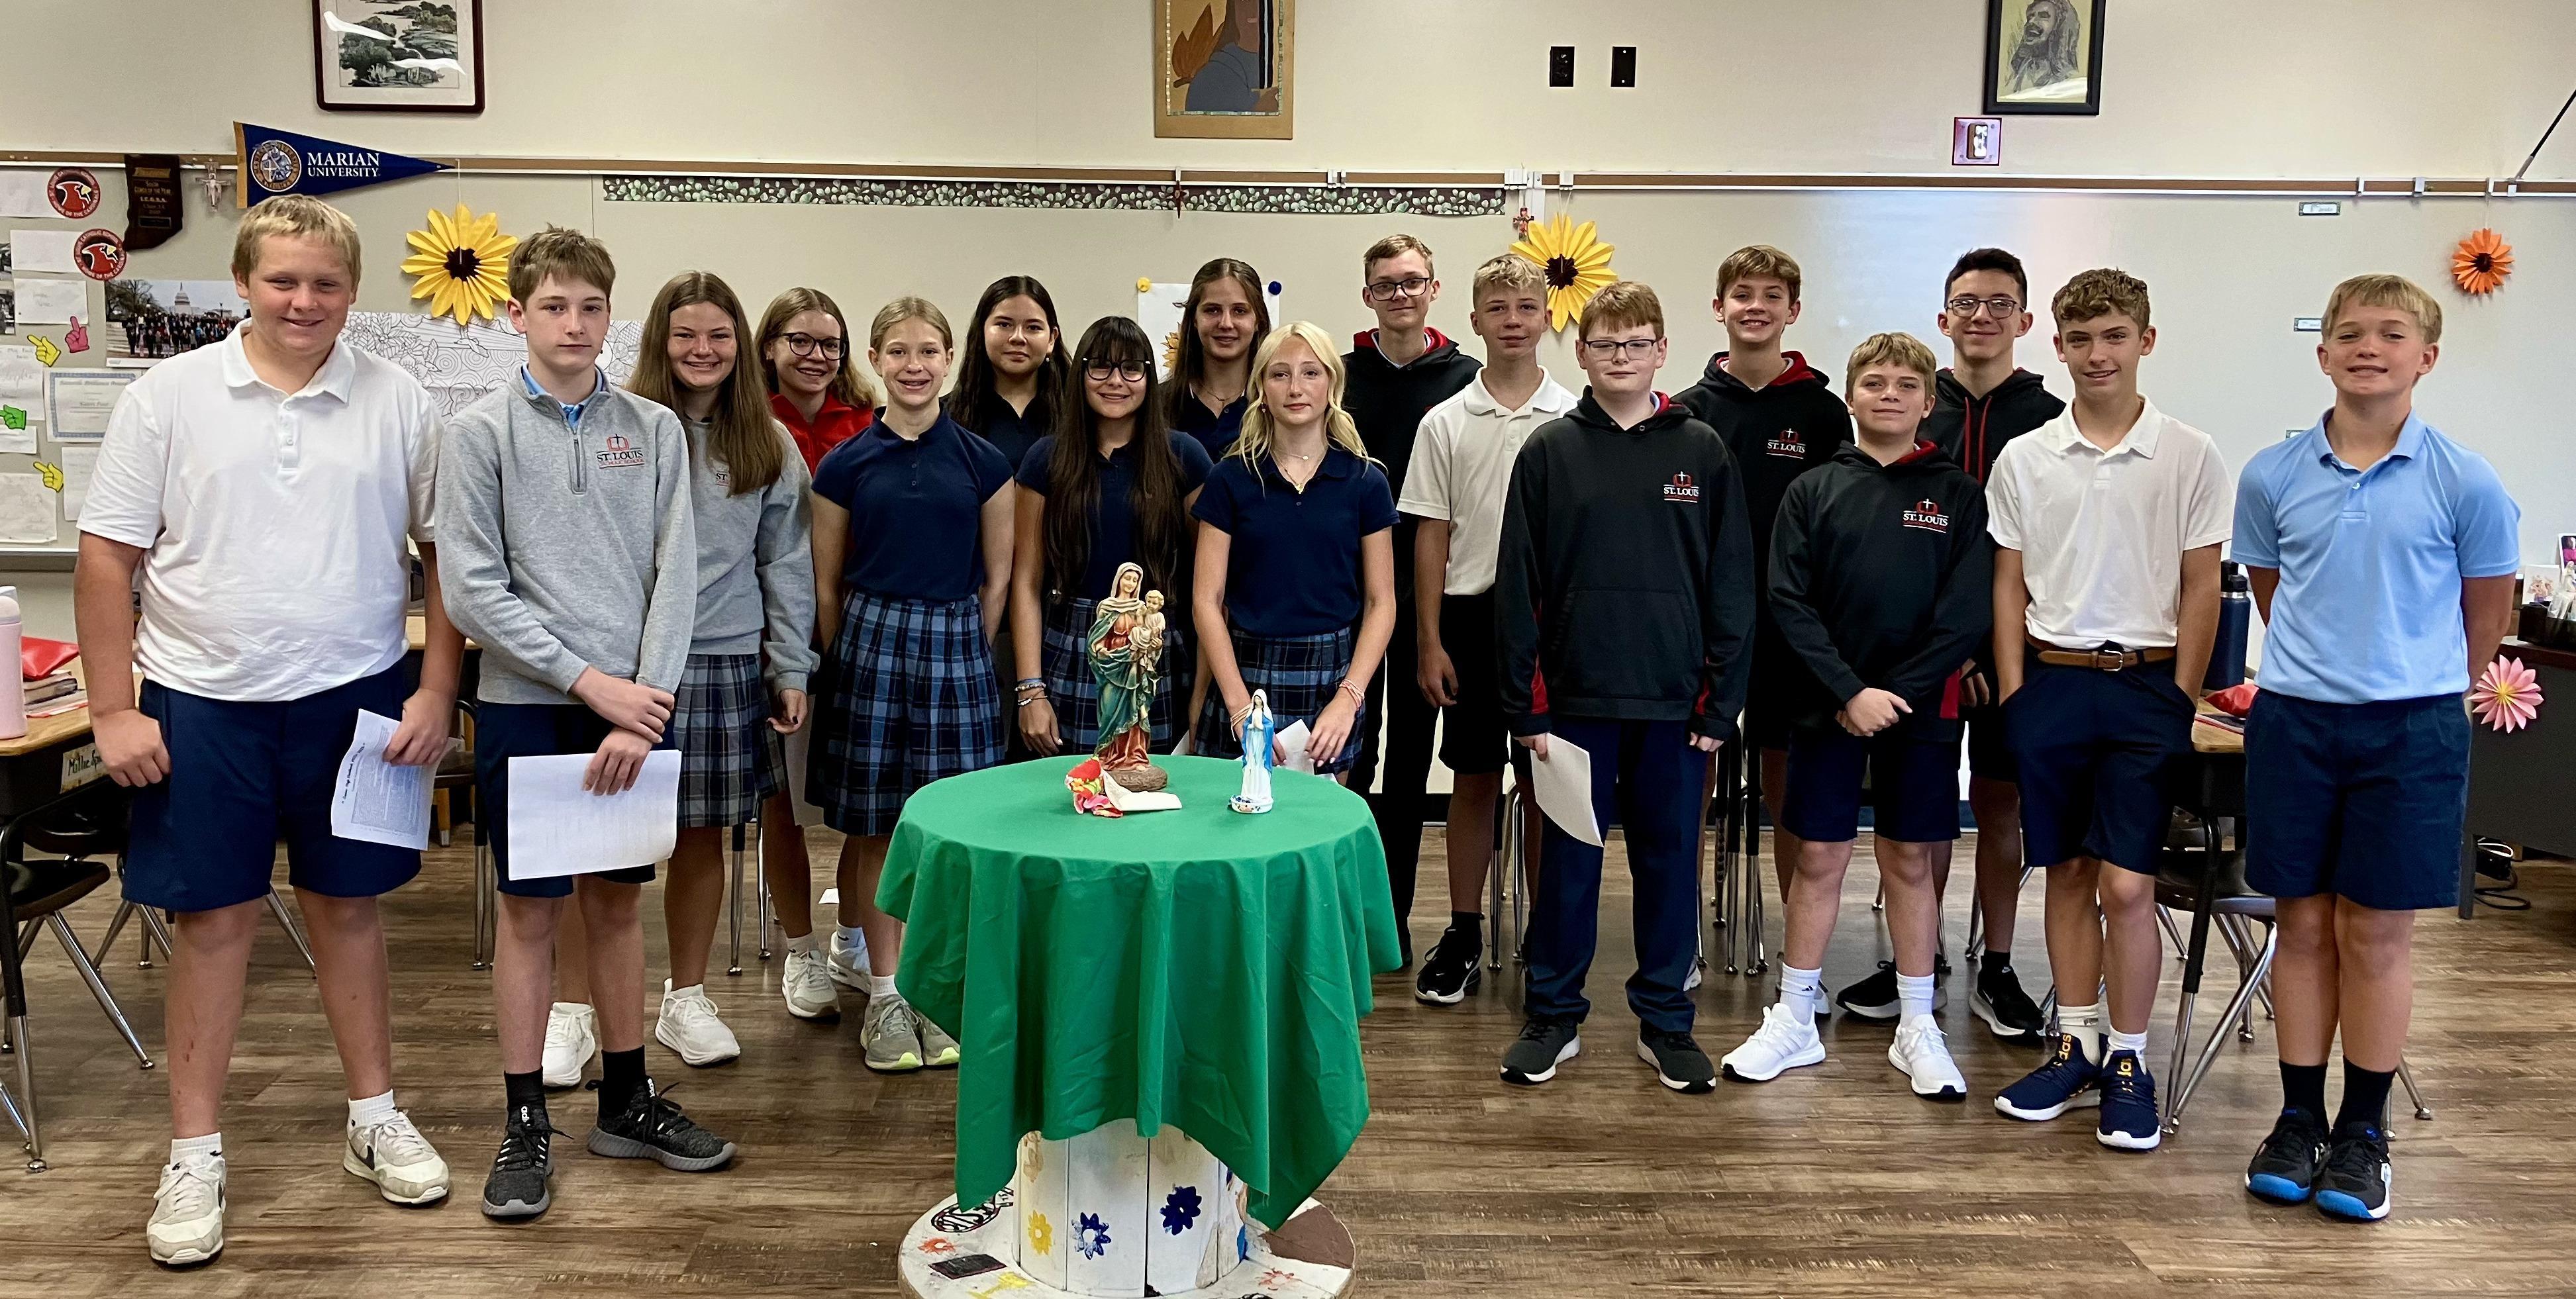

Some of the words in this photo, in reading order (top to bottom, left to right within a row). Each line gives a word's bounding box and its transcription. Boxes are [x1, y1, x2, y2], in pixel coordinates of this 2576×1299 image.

[307, 152, 380, 166] MARIAN
[308, 167, 379, 177] UNIVERSITY
[1780, 443, 1805, 454] LOUIS
[597, 453, 612, 461] ST.
[613, 450, 644, 460] LOUIS
[1677, 487, 1699, 497] LOUIS
[1918, 514, 1948, 526] LOUIS
